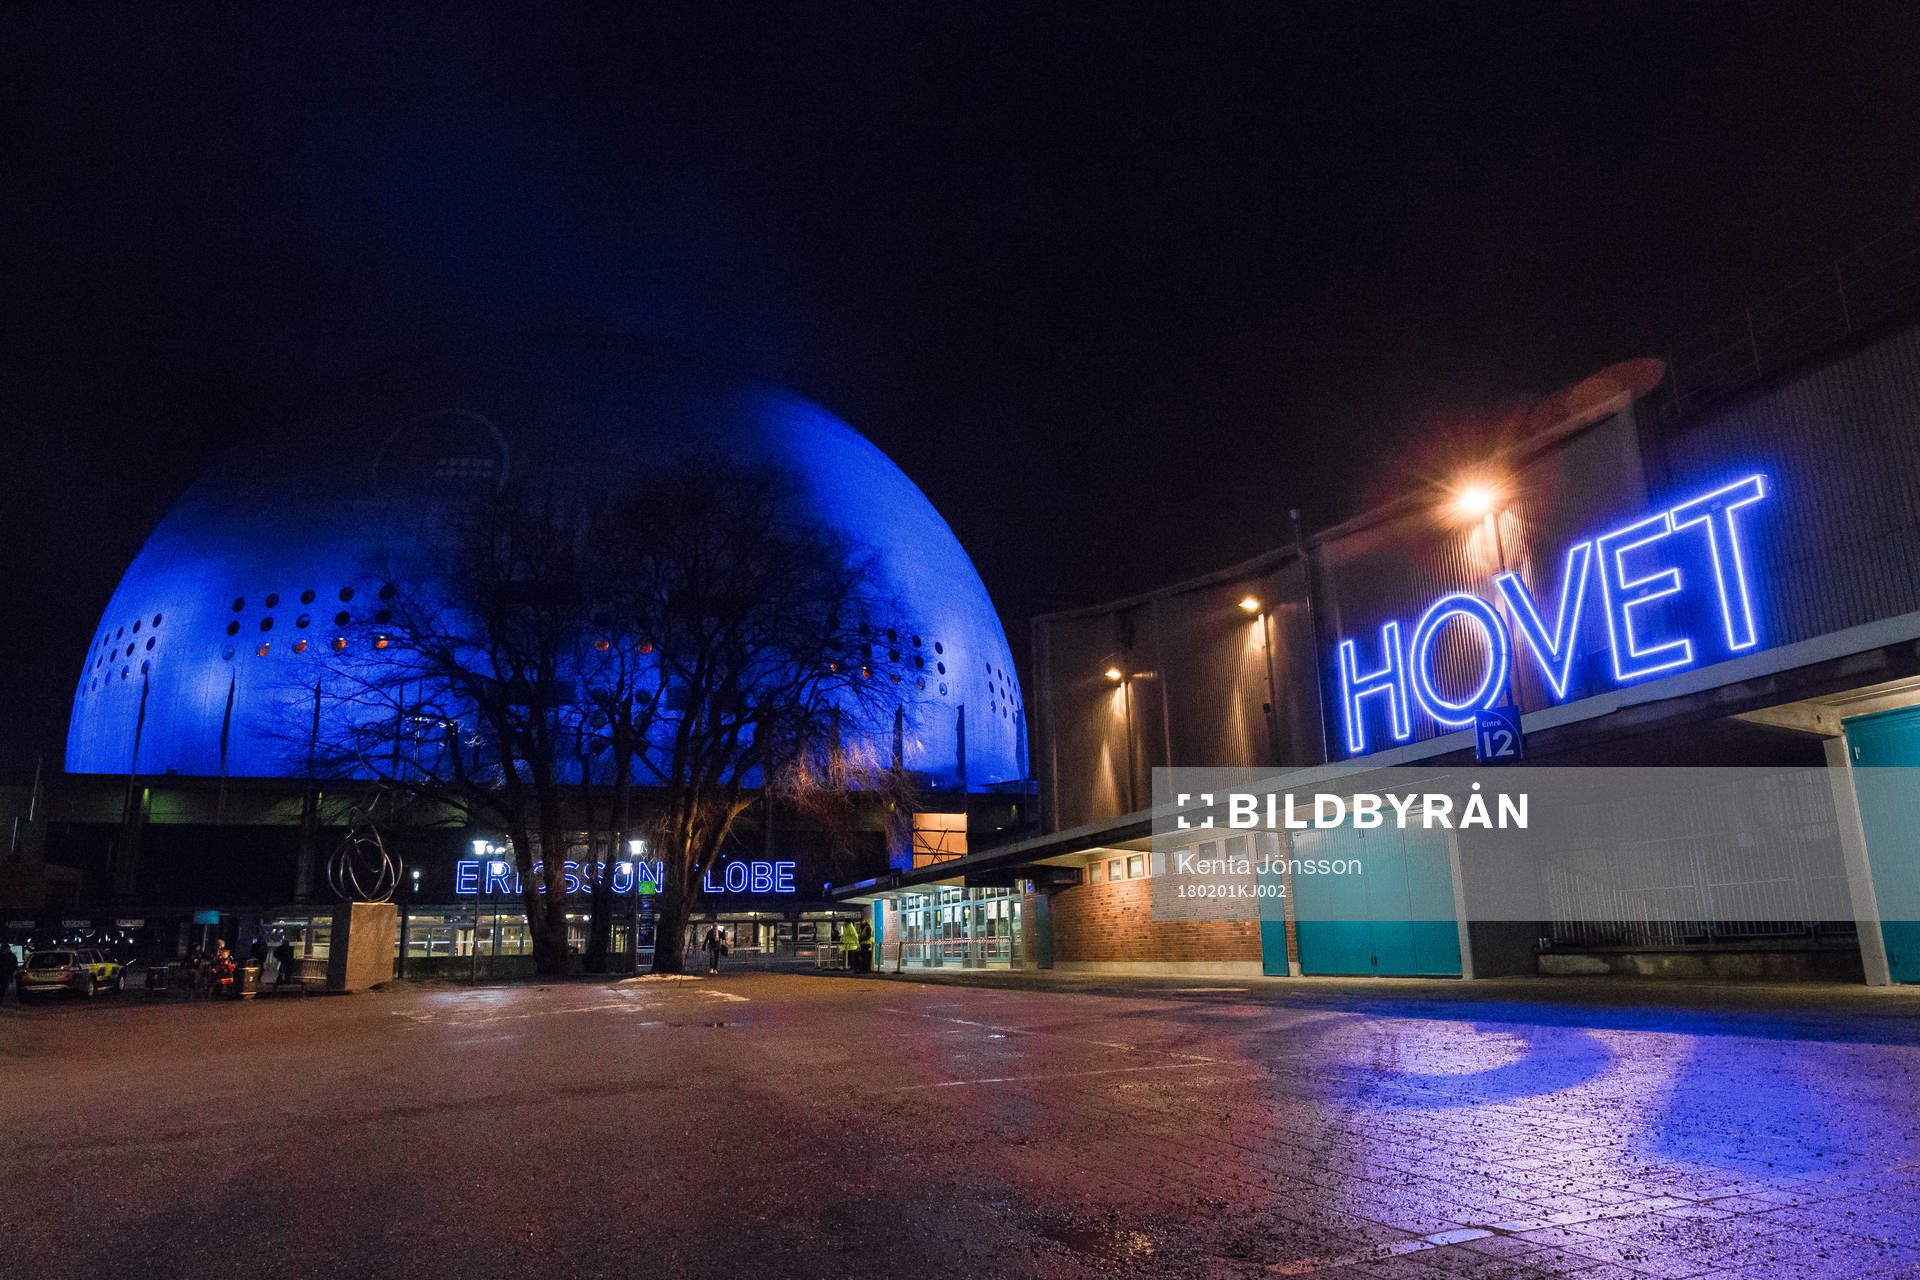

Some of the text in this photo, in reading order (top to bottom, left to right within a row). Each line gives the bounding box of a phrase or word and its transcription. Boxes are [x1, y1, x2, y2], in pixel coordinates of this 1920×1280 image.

[1339, 474, 1766, 752] HOVET
[1483, 729, 1514, 757] 12
[694, 861, 796, 893] LOBE
